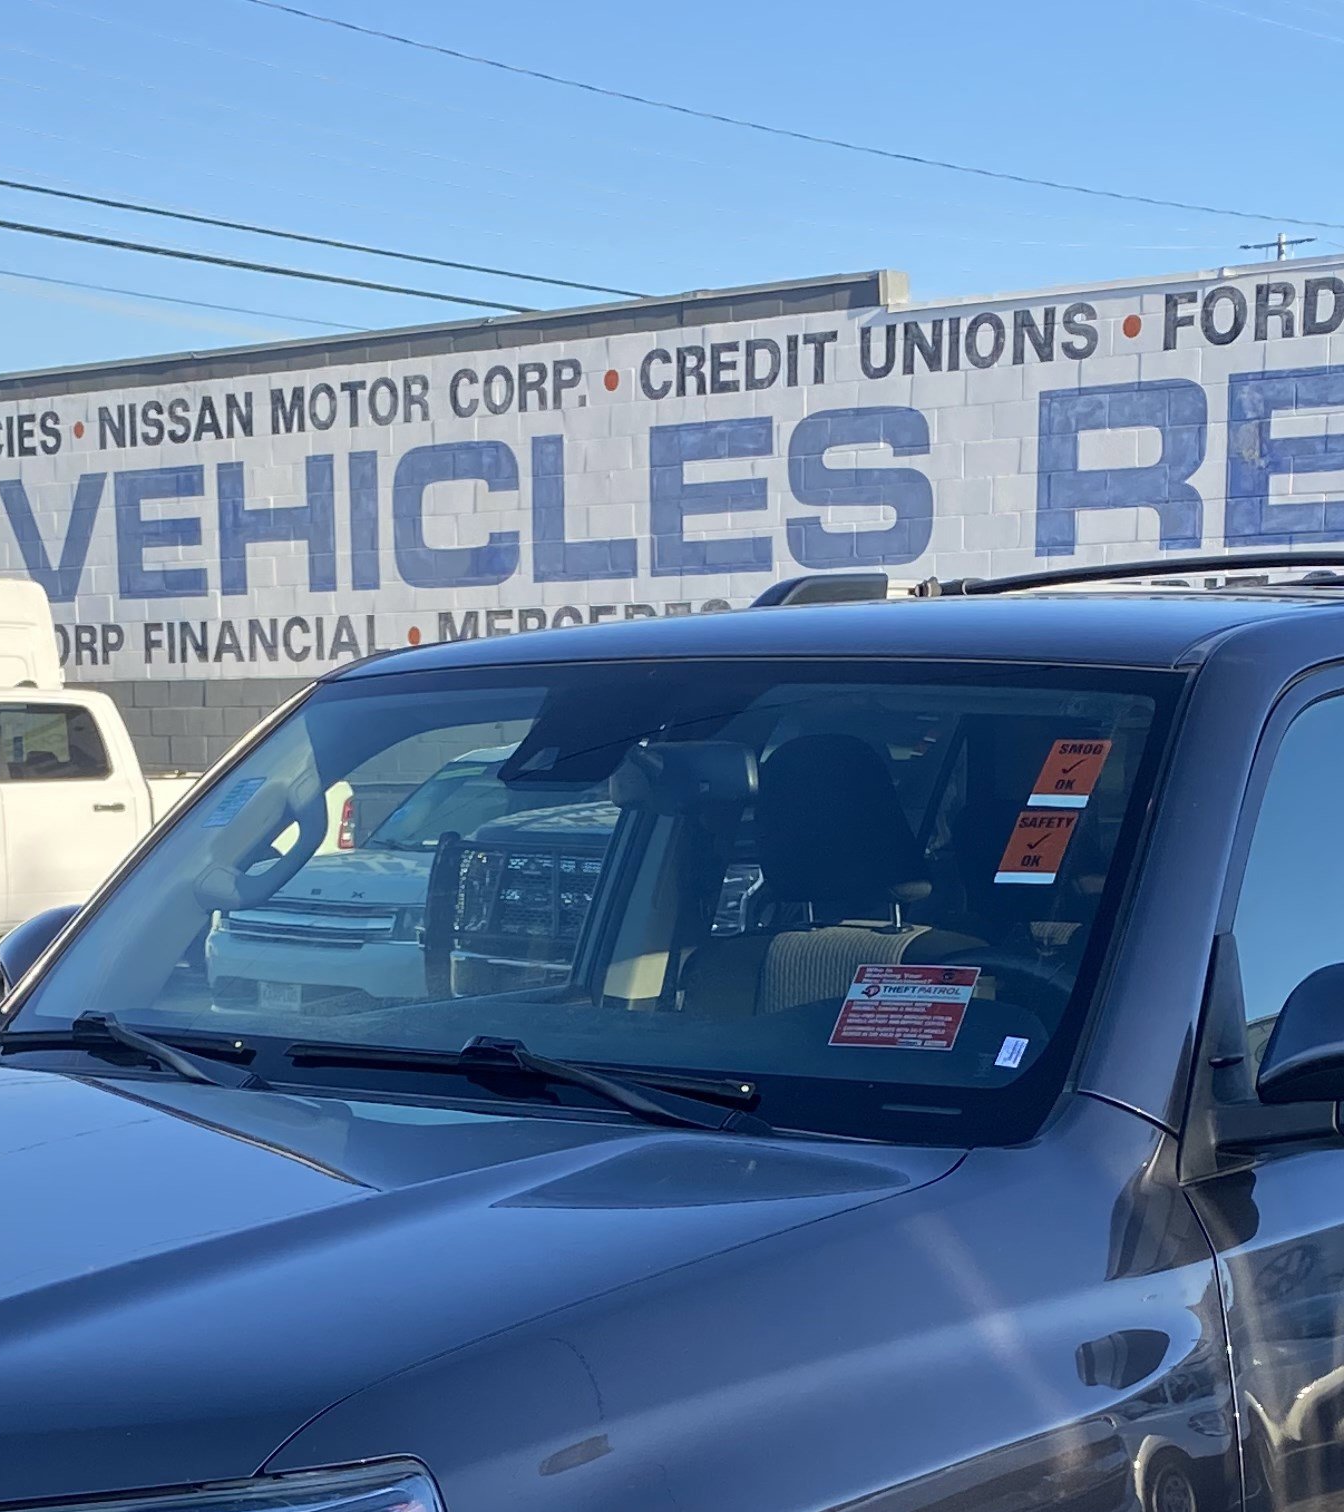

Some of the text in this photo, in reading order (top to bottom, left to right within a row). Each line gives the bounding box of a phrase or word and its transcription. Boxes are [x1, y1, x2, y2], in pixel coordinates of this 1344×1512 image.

[98, 391, 253, 450] NISSAN
[271, 373, 430, 435] MOTOR
[449, 358, 587, 419] CORP.
[639, 330, 838, 400] CREDIT
[860, 302, 1099, 380] UNIONS
[143, 614, 393, 664] FINANCIAL
[1058, 743, 1104, 755] SMOG
[1054, 779, 1076, 791] OK
[1018, 816, 1075, 829] SAFETY
[1020, 855, 1043, 867] OK
